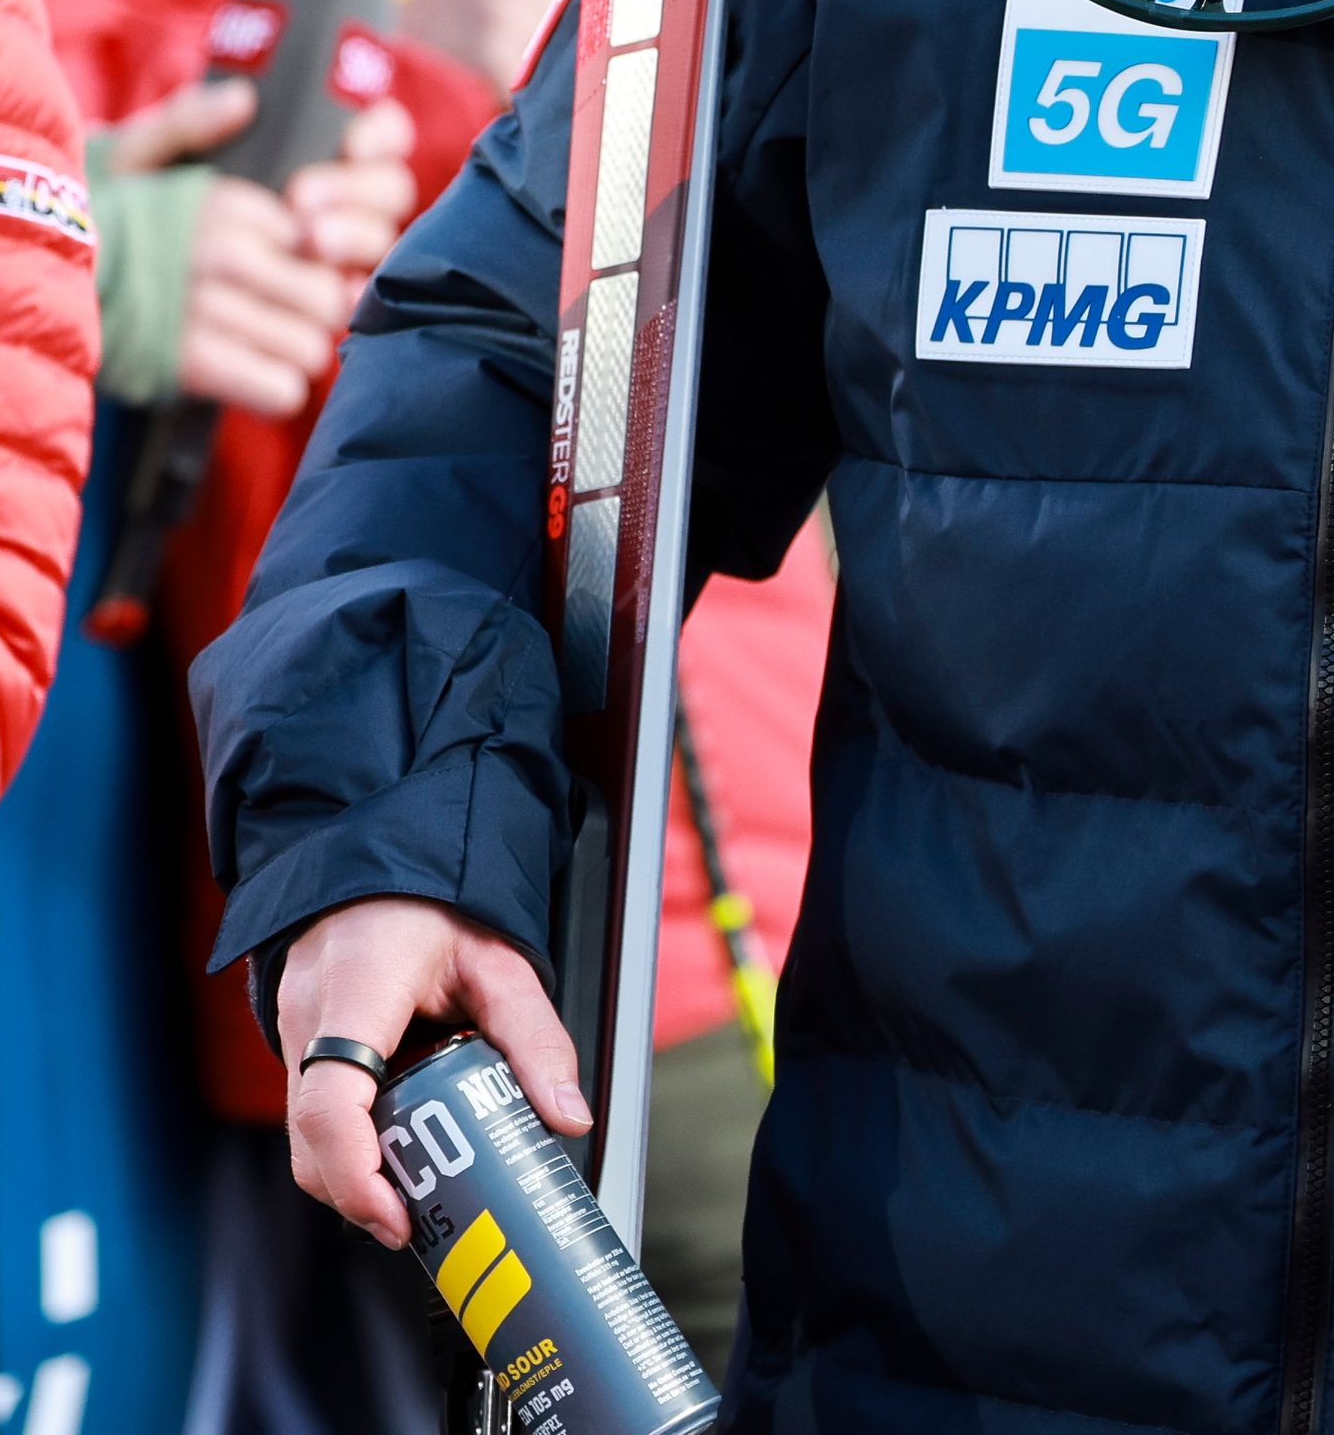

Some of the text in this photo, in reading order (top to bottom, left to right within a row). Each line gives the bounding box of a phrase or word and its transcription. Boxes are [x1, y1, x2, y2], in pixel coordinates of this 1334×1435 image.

[1026, 58, 1183, 149] 5G
[930, 277, 1173, 351] KPMG
[550, 328, 581, 486] REDSTER
[378, 1099, 476, 1201] CO
[411, 1202, 456, 1256] US
[506, 1337, 559, 1381] SOUR
[527, 1390, 553, 1416] 105
[549, 1377, 576, 1403] mg
